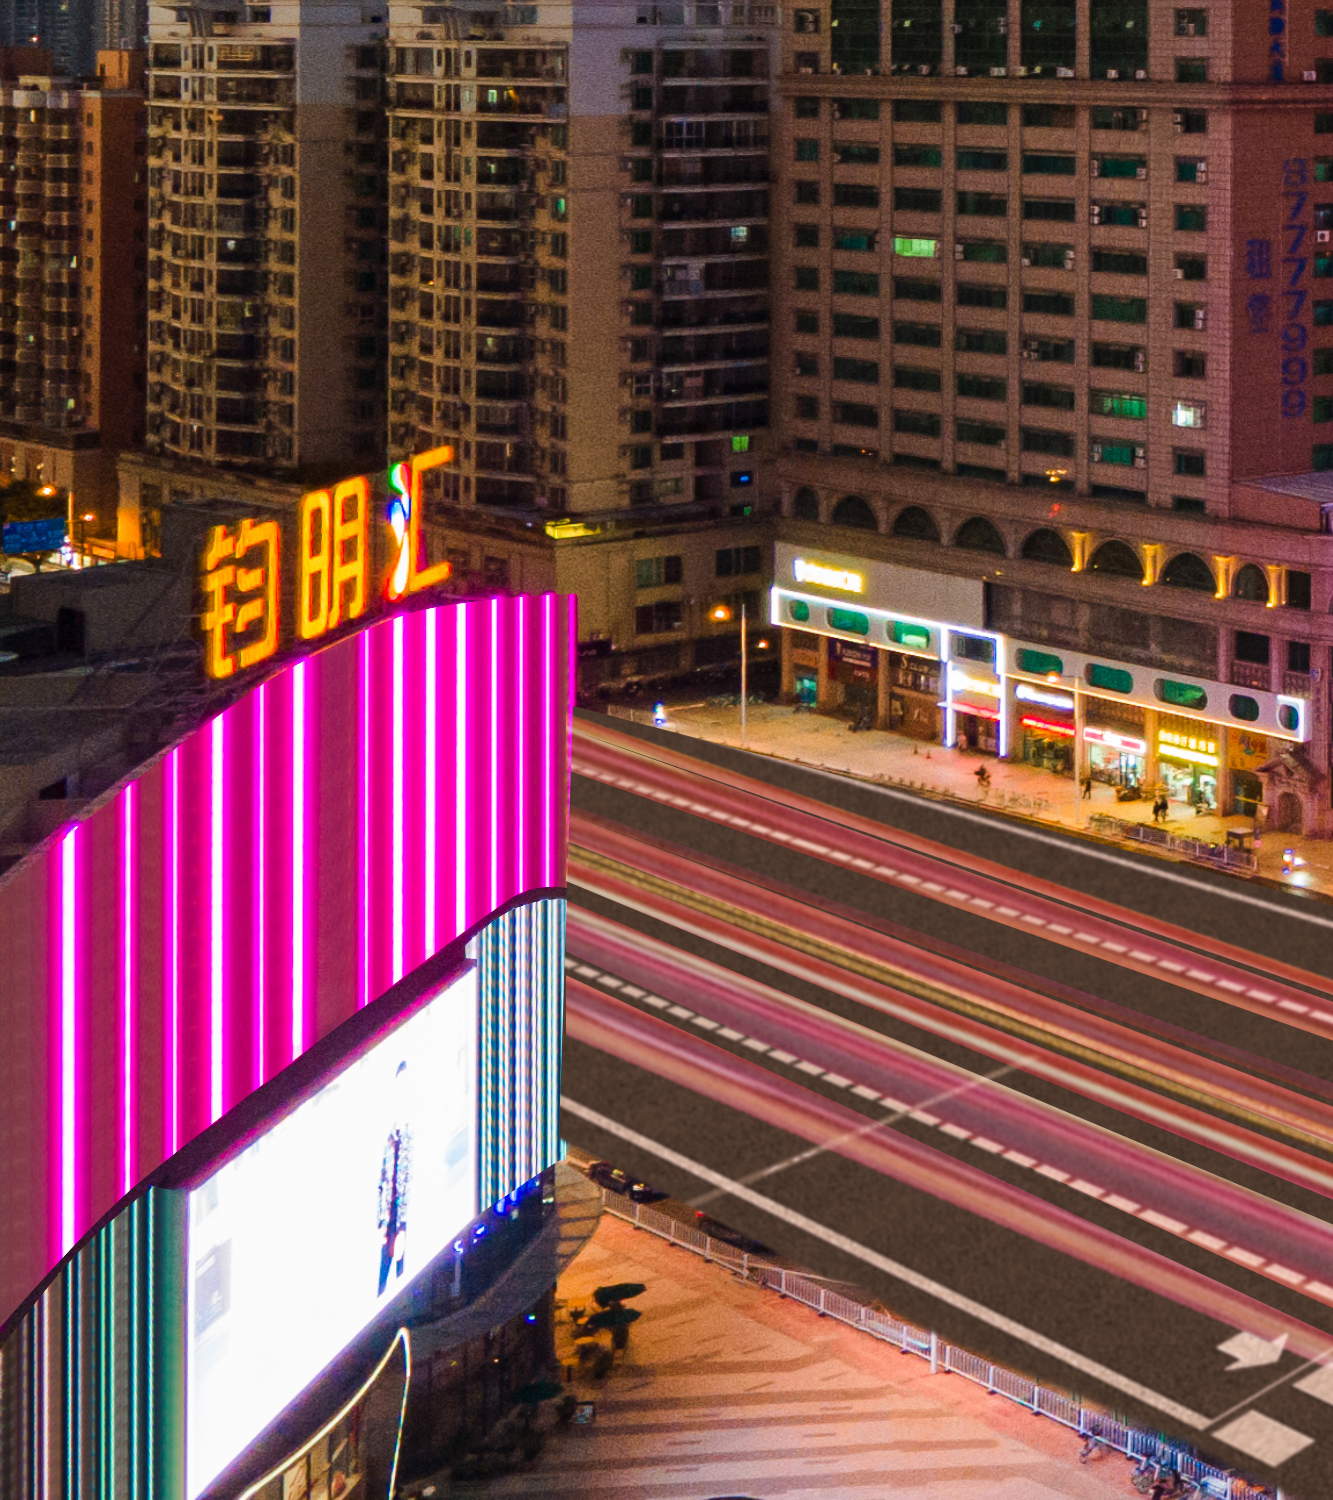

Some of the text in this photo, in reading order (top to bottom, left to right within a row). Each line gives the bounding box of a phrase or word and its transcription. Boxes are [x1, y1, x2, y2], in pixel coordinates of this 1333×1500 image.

[1282, 158, 1307, 417] 87777999
[201, 446, 453, 678] 钧明汇
